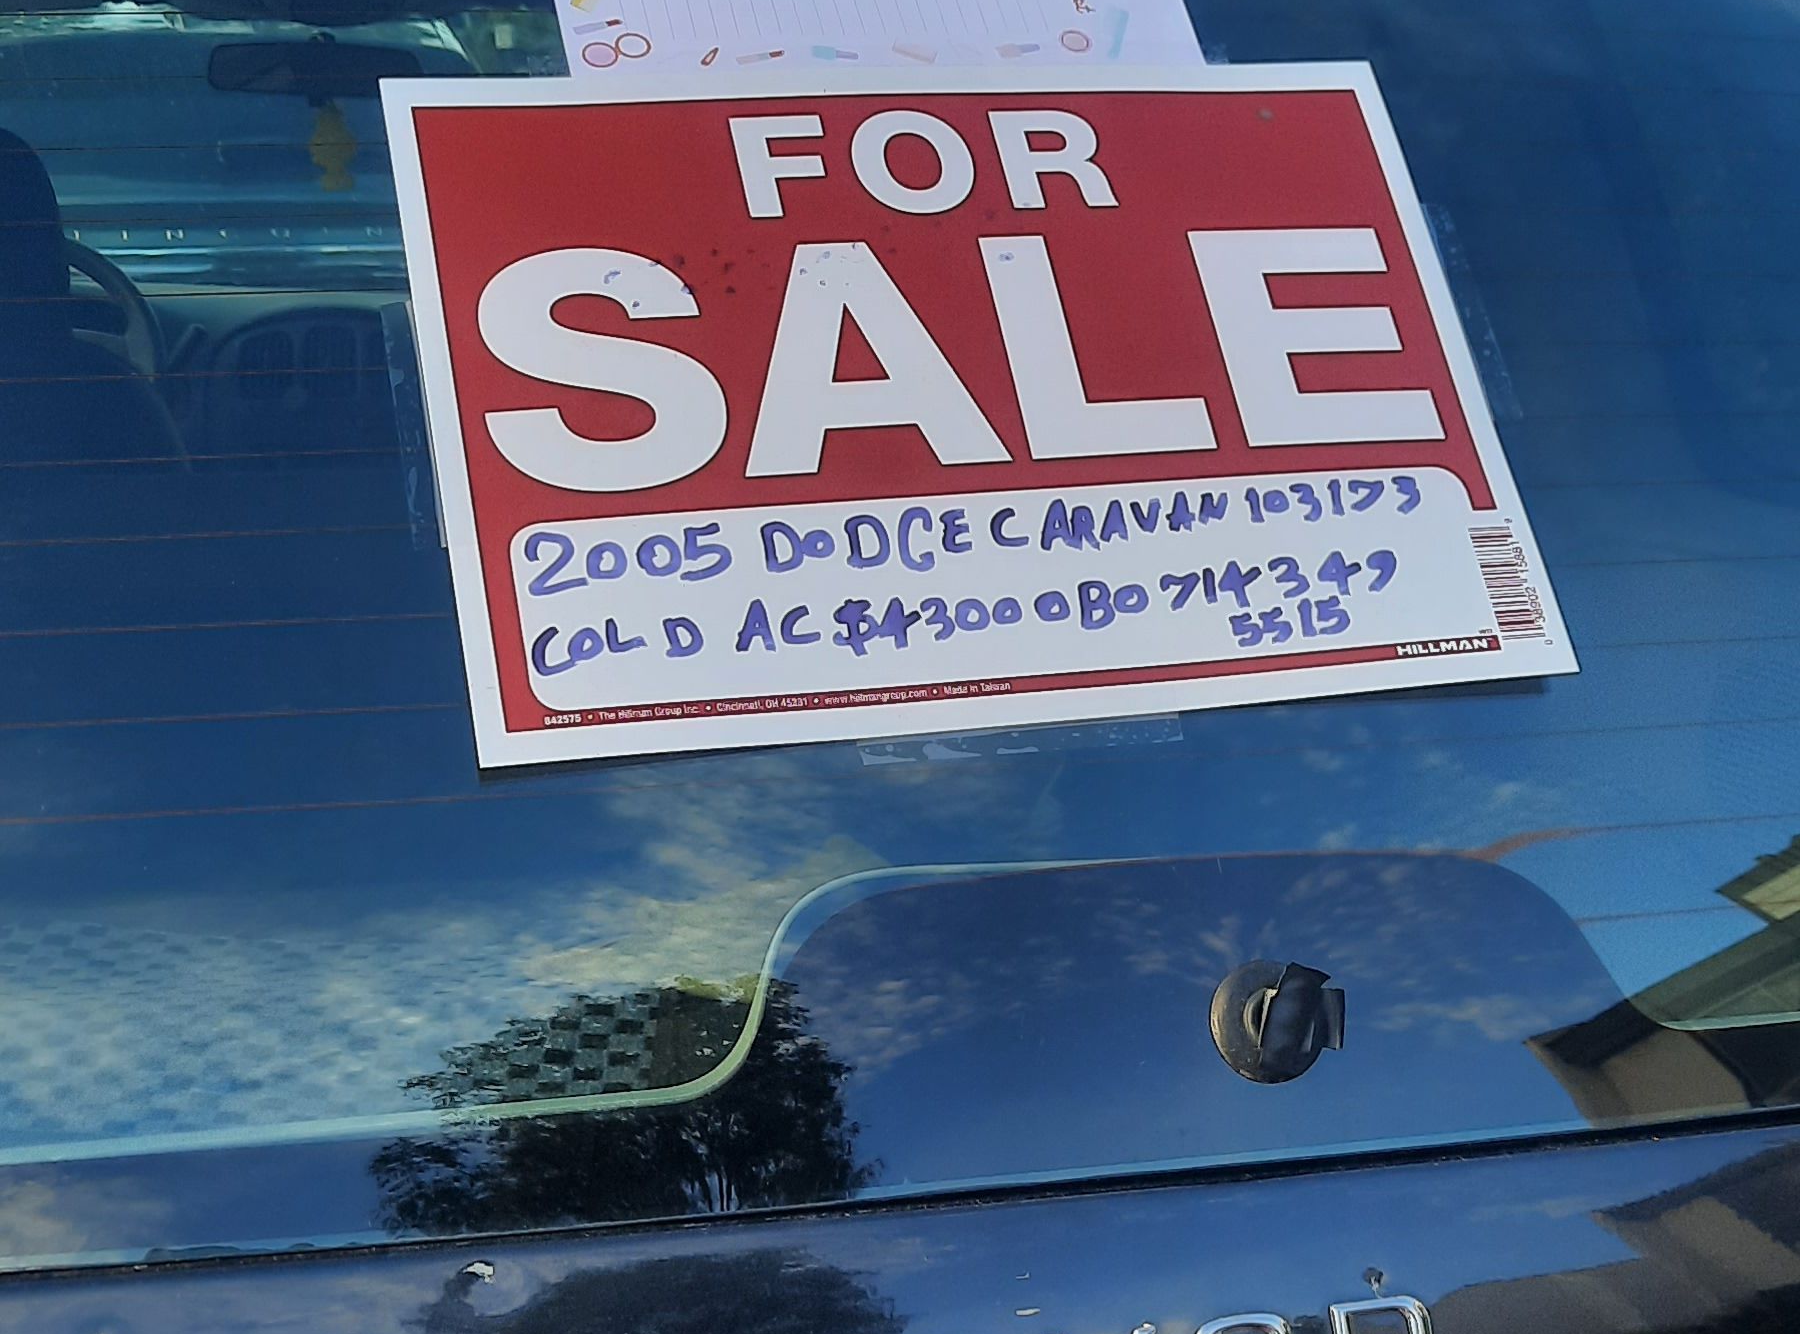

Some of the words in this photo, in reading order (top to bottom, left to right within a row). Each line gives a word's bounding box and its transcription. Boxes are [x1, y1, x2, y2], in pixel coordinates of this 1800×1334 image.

[727, 108, 1119, 219] FOR
[475, 227, 1447, 492] SALE
[524, 523, 733, 597] 2005
[990, 491, 1228, 551] CARAVAN
[1245, 476, 1421, 524] 103173
[1509, 540, 1529, 574] 15881
[531, 616, 704, 676] COLD
[735, 598, 821, 653] AC
[1229, 595, 1351, 648] 5515
[1396, 637, 1488, 656] HILLMAN
[599, 711, 616, 721] The
[655, 706, 682, 717] Group
[943, 685, 968, 695] Made
[970, 684, 979, 692] in
[981, 681, 1011, 691] Taiwan
